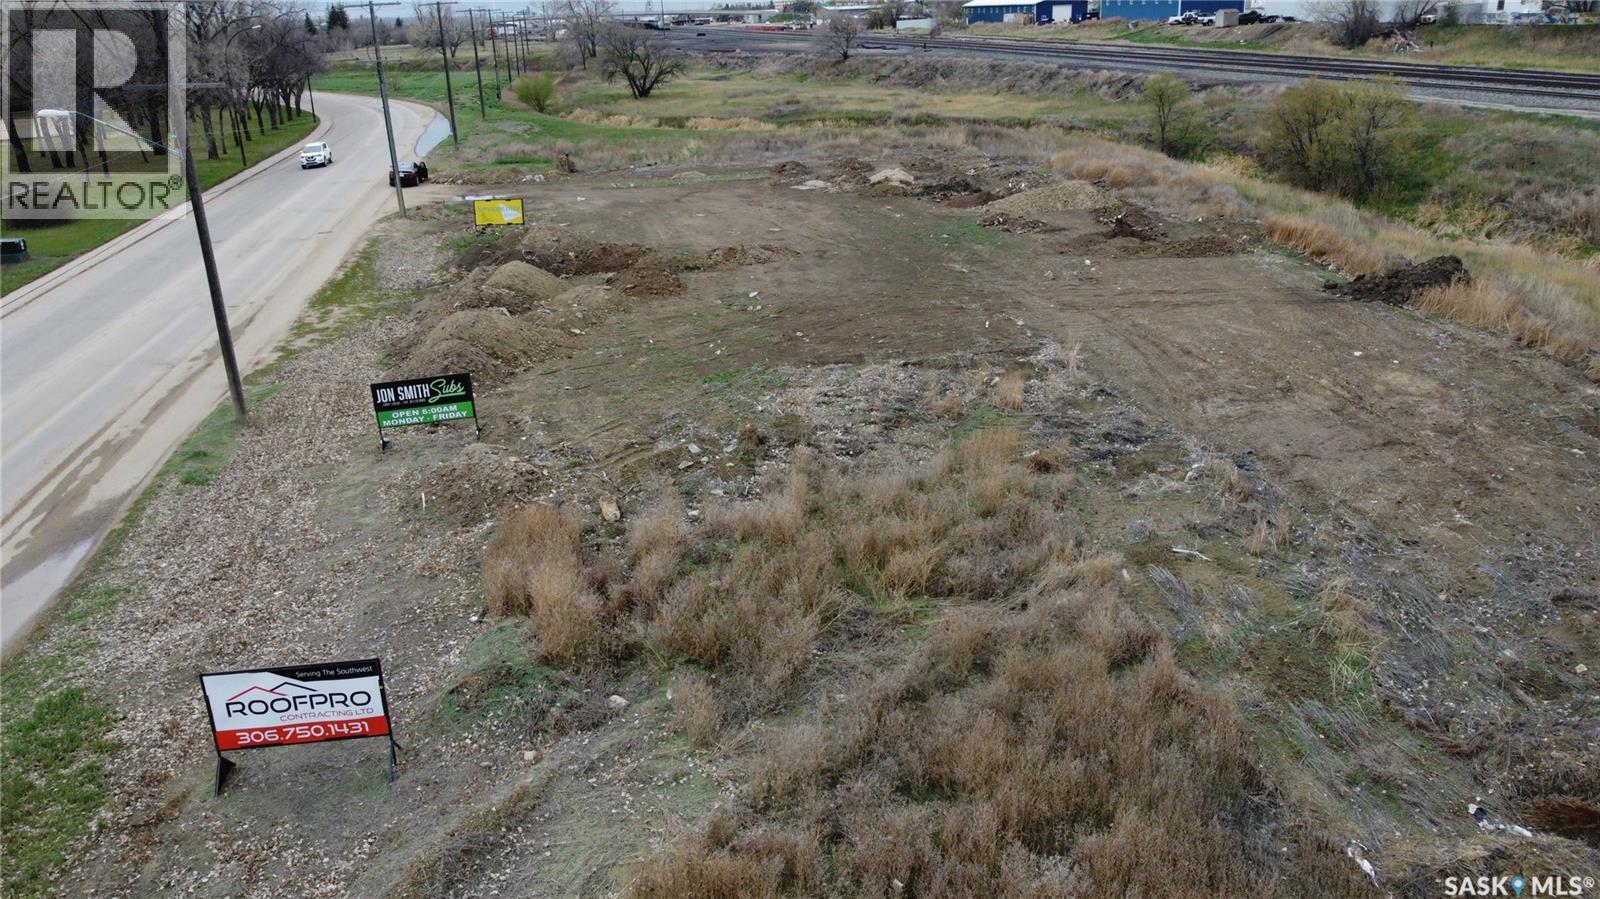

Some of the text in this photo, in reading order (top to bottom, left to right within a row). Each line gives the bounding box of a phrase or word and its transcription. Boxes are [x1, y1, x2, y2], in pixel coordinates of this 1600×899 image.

[376, 388, 395, 403] JON
[397, 384, 430, 400] SMITH
[428, 379, 466, 403] Subs
[383, 415, 425, 427] MONDAY
[433, 410, 468, 421] FRIDAY
[392, 405, 458, 418] OPEN 6:00AM
[295, 665, 373, 680] Serving The Southwest
[225, 690, 372, 718] ROOFPRO
[279, 707, 375, 722] CONTRACTING LTD
[235, 721, 370, 745] 306.750.1431
